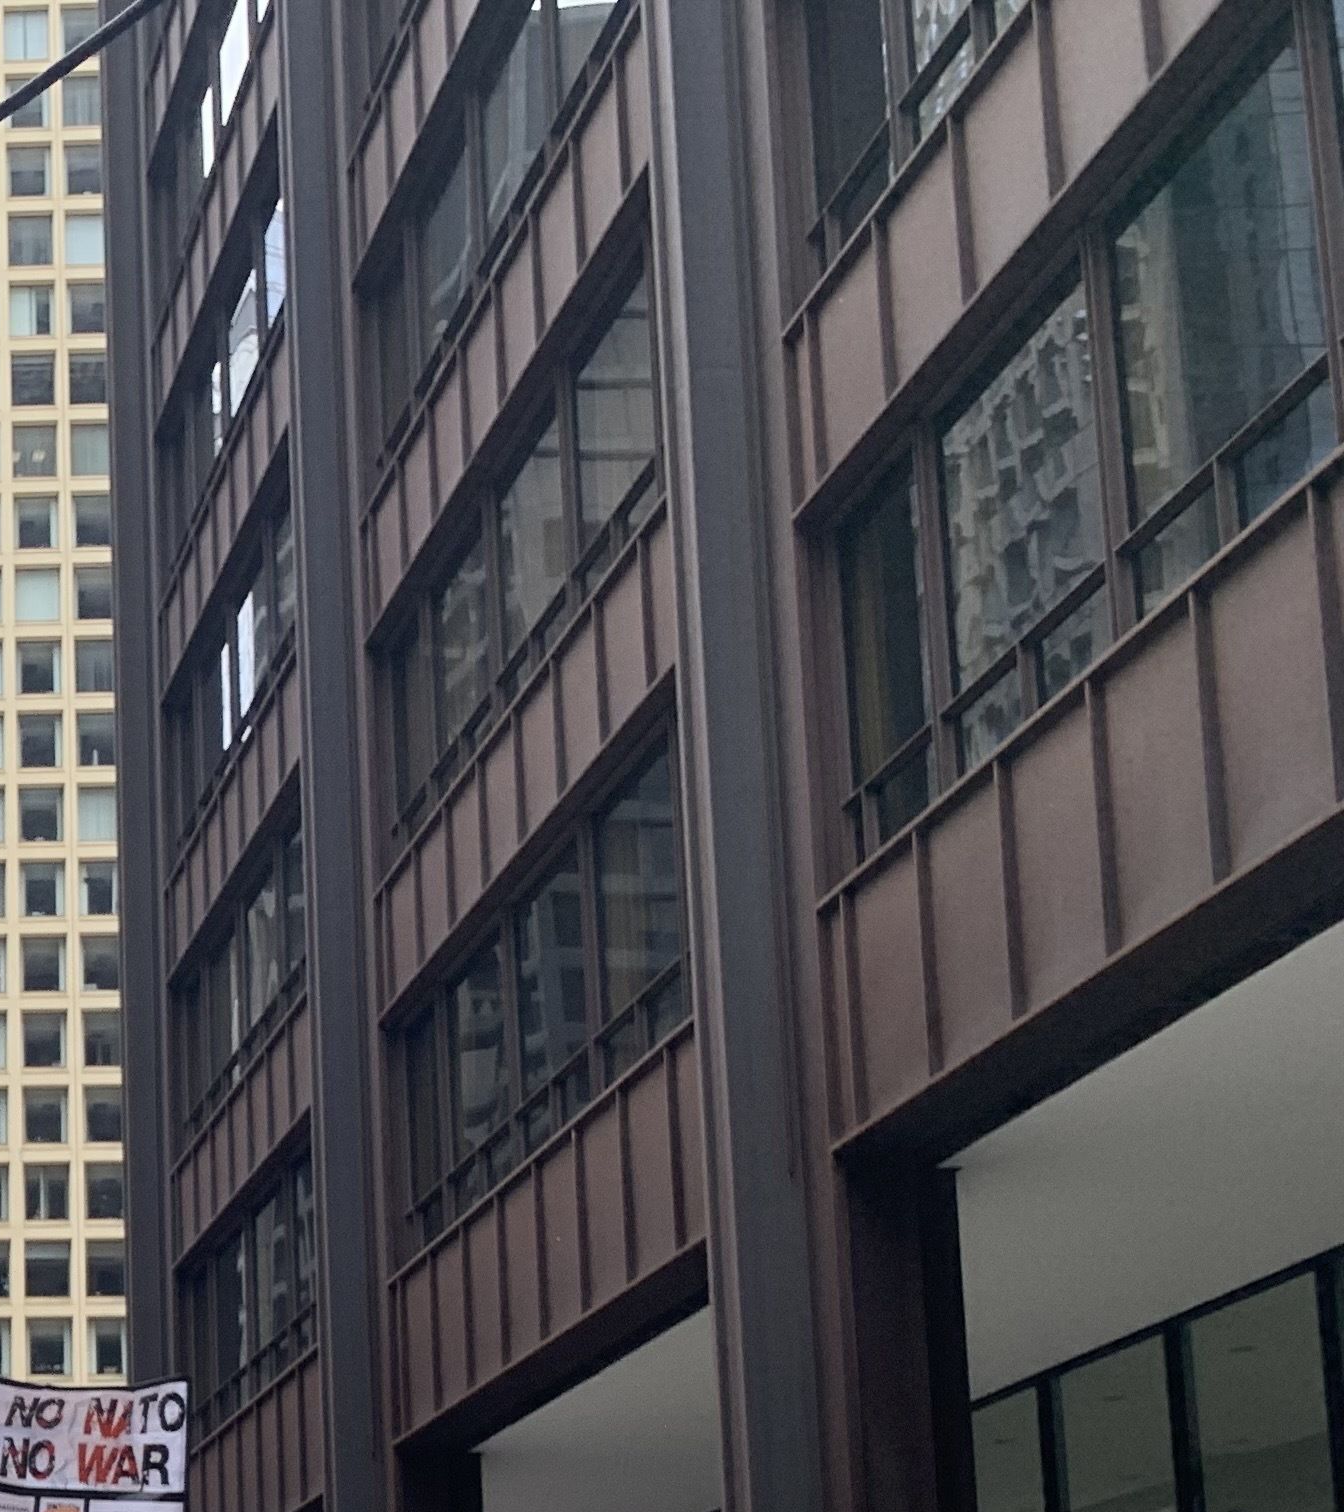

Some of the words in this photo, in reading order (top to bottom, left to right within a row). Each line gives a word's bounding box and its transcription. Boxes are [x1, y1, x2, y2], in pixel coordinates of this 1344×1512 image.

[5, 1395, 66, 1430] NO
[83, 1391, 186, 1439] NATO
[0, 1436, 56, 1480] NO
[77, 1442, 171, 1486] WAR
